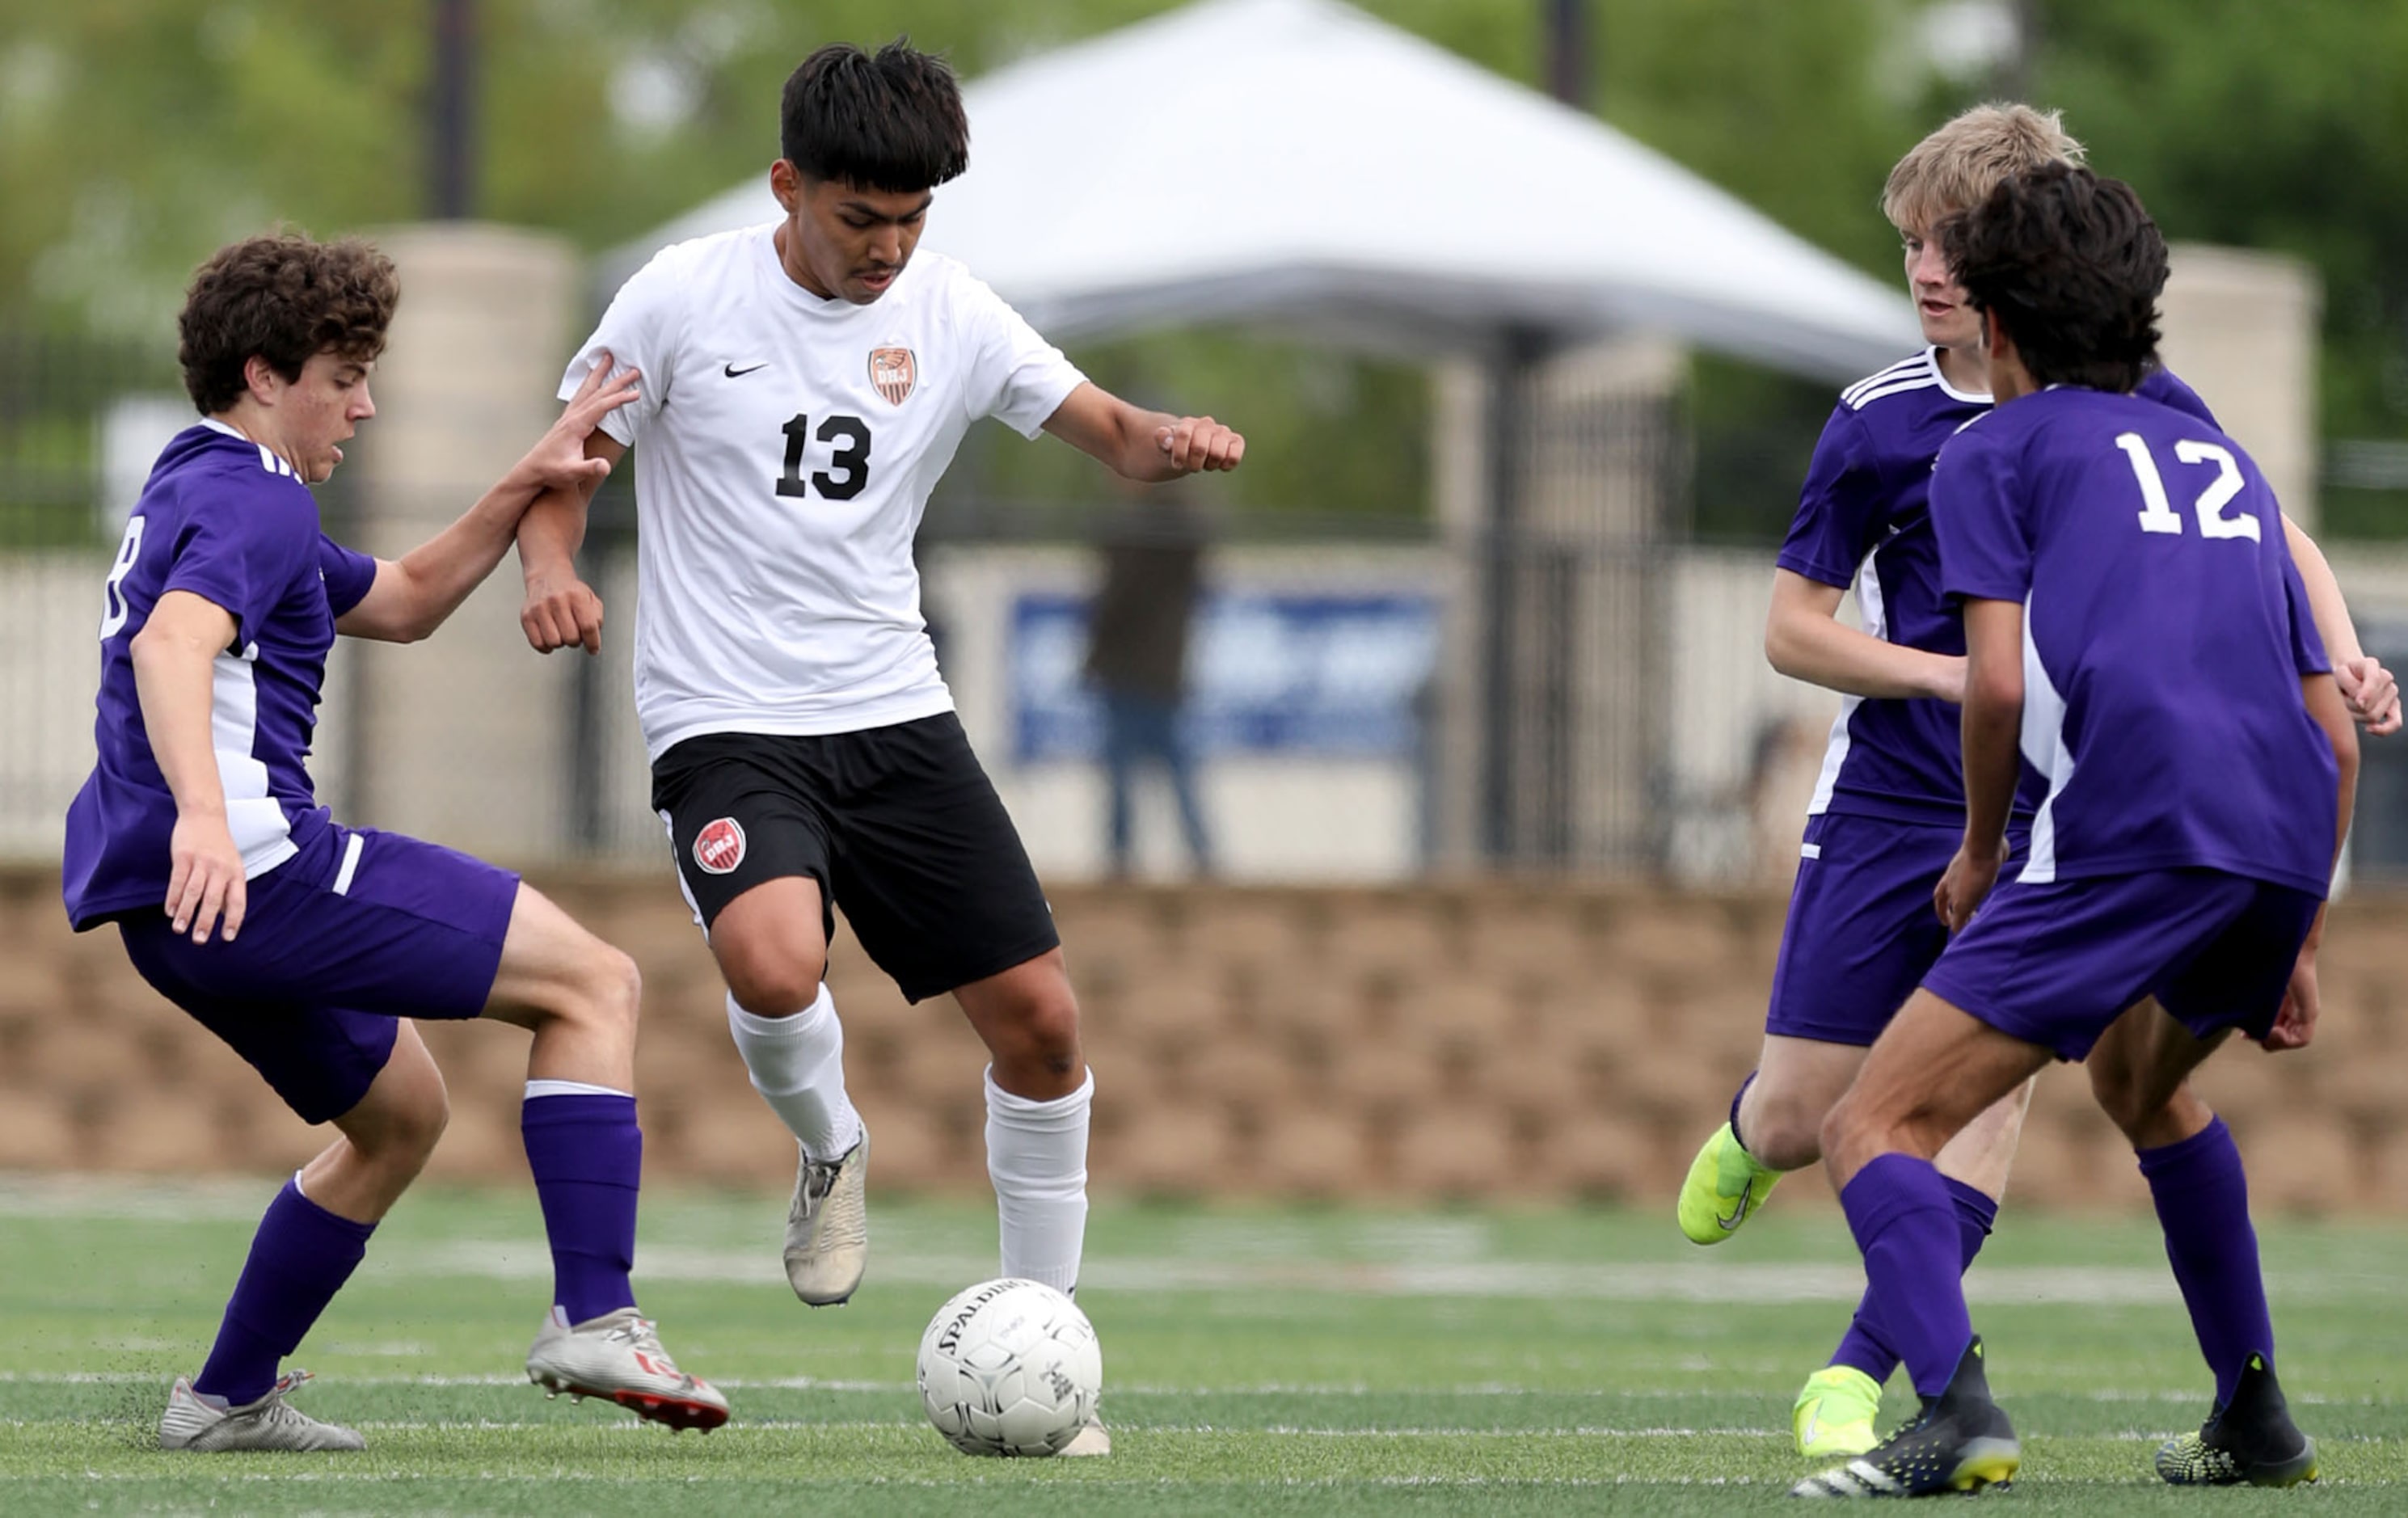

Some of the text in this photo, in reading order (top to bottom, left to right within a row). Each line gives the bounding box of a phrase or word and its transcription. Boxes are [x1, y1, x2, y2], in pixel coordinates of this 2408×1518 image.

[775, 414, 871, 500] 13
[2115, 432, 2261, 543] 12
[99, 516, 145, 641] 8
